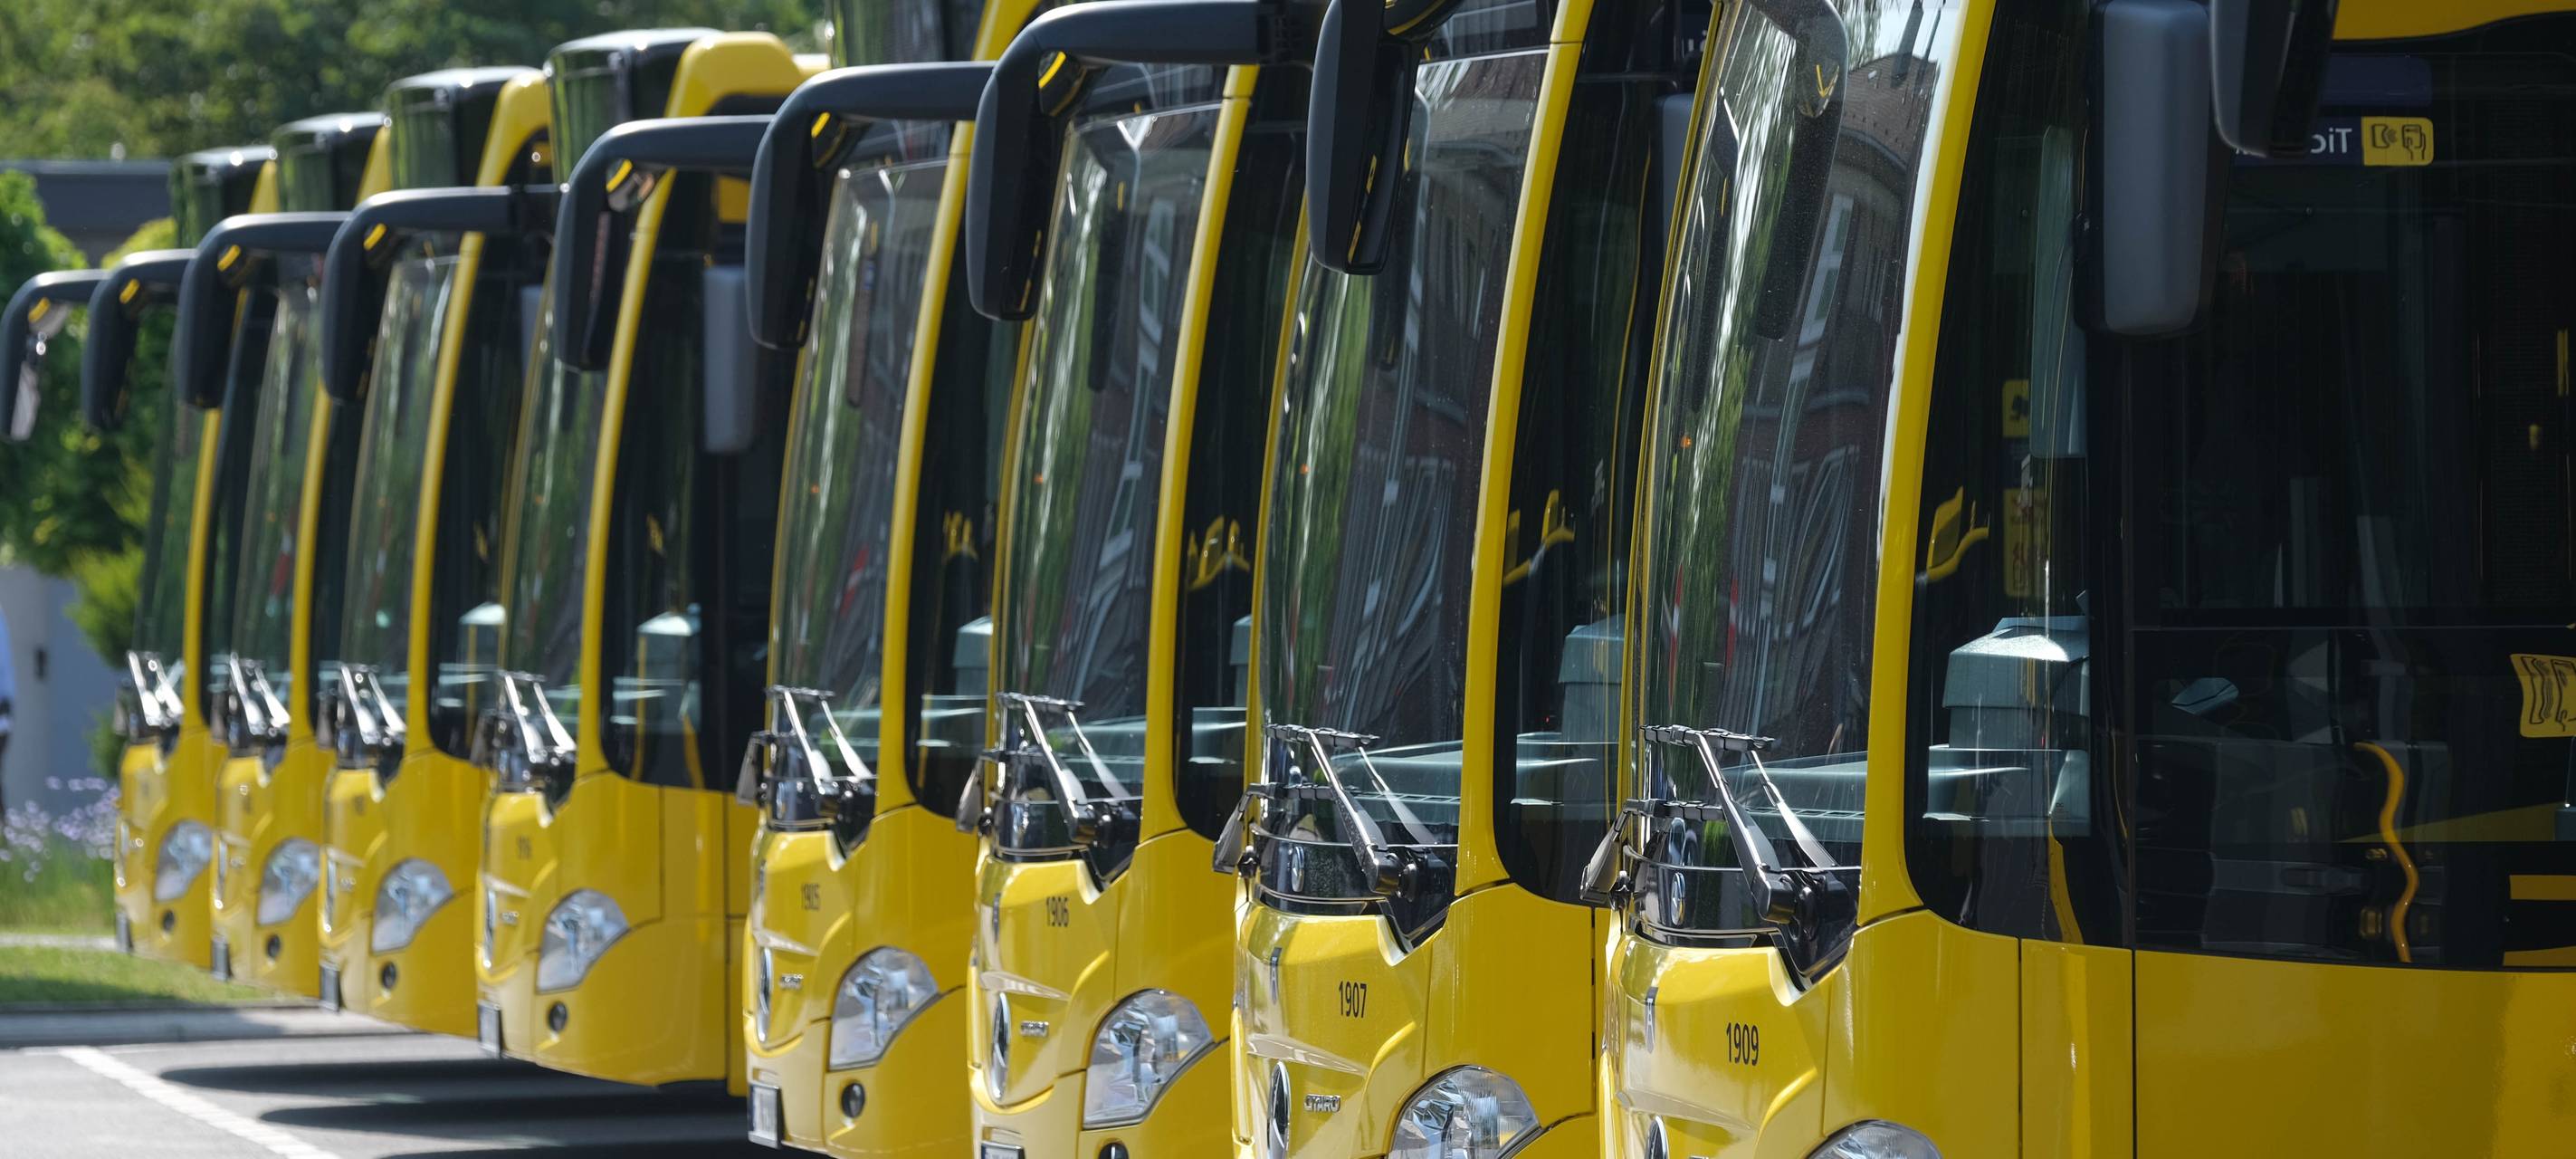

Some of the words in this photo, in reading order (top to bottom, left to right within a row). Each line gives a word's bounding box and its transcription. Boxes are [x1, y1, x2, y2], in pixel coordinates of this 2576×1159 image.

[1046, 896, 1070, 927] 1906
[1339, 981, 1368, 1019] 1907
[1726, 1022, 1759, 1066] 1909
